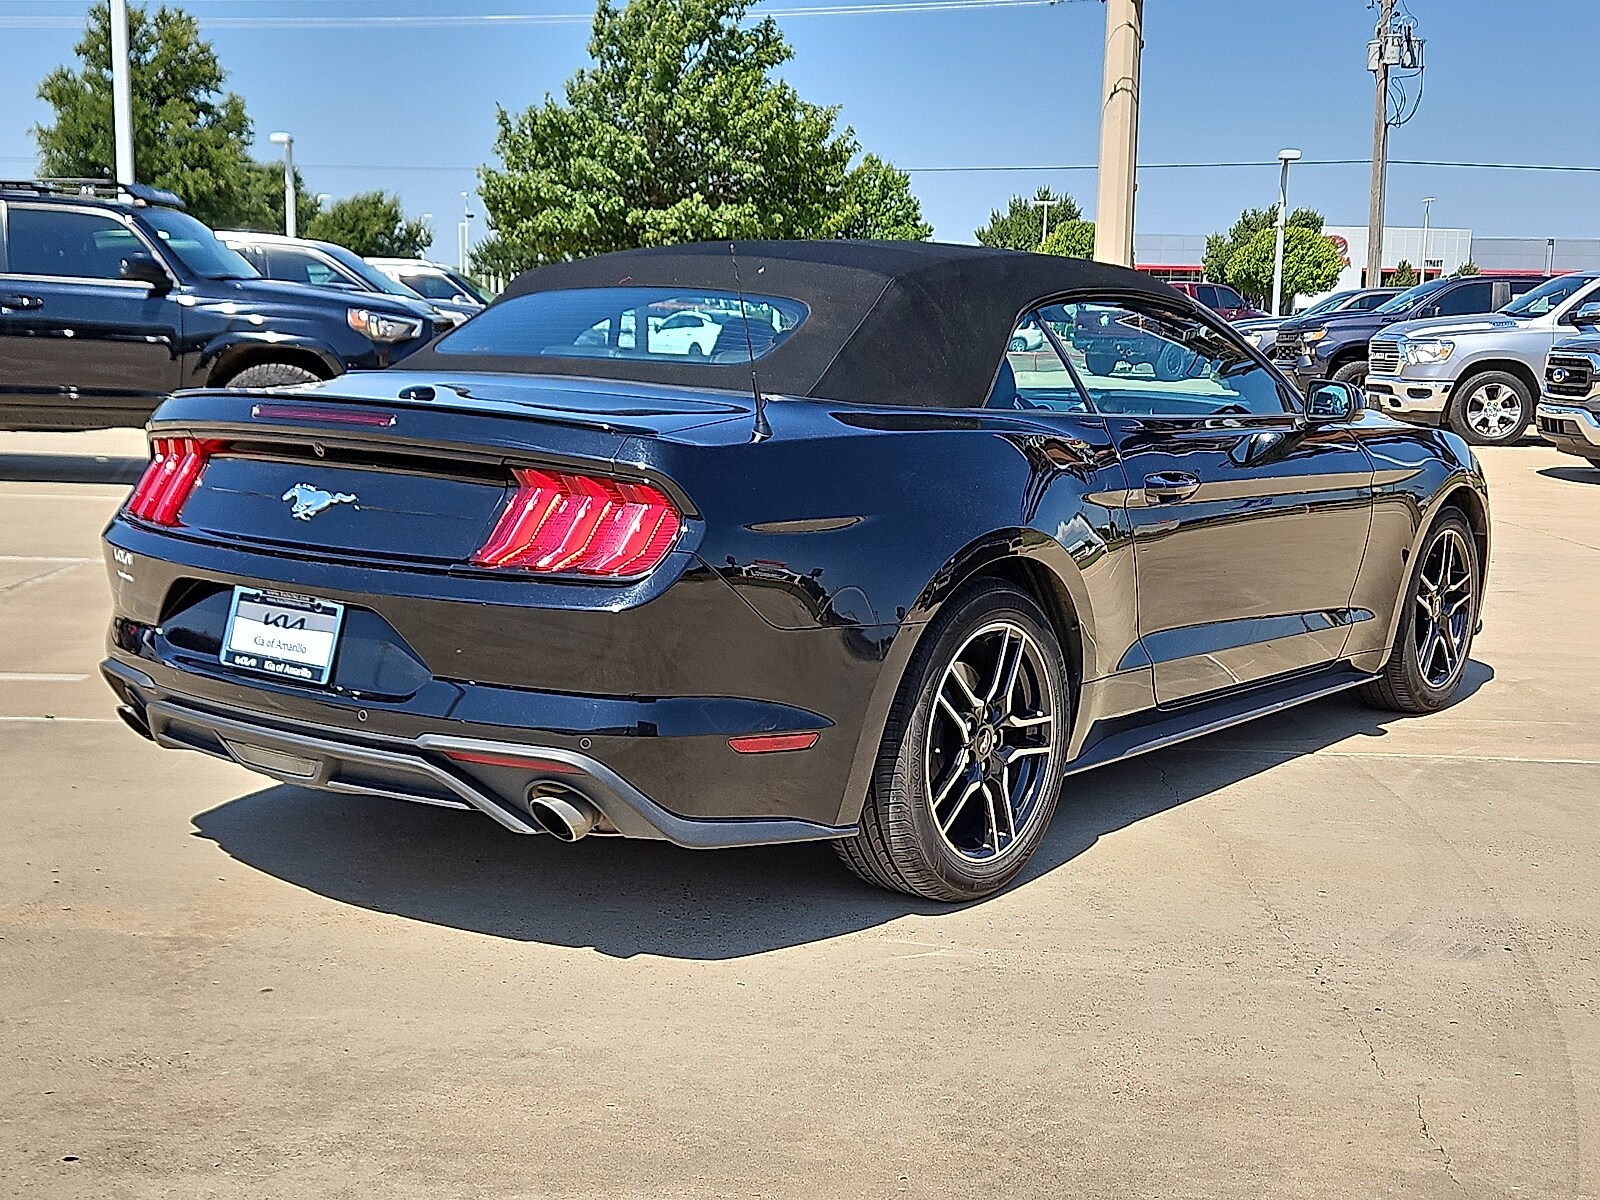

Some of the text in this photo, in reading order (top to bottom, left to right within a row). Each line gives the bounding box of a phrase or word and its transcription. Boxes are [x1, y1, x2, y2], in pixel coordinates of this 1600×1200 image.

[263, 612, 306, 630] KIA
[254, 636, 307, 654] Kia of Amarillo
[263, 660, 275, 672] Kia
[275, 663, 285, 673] of
[284, 665, 312, 679] Amarillo
